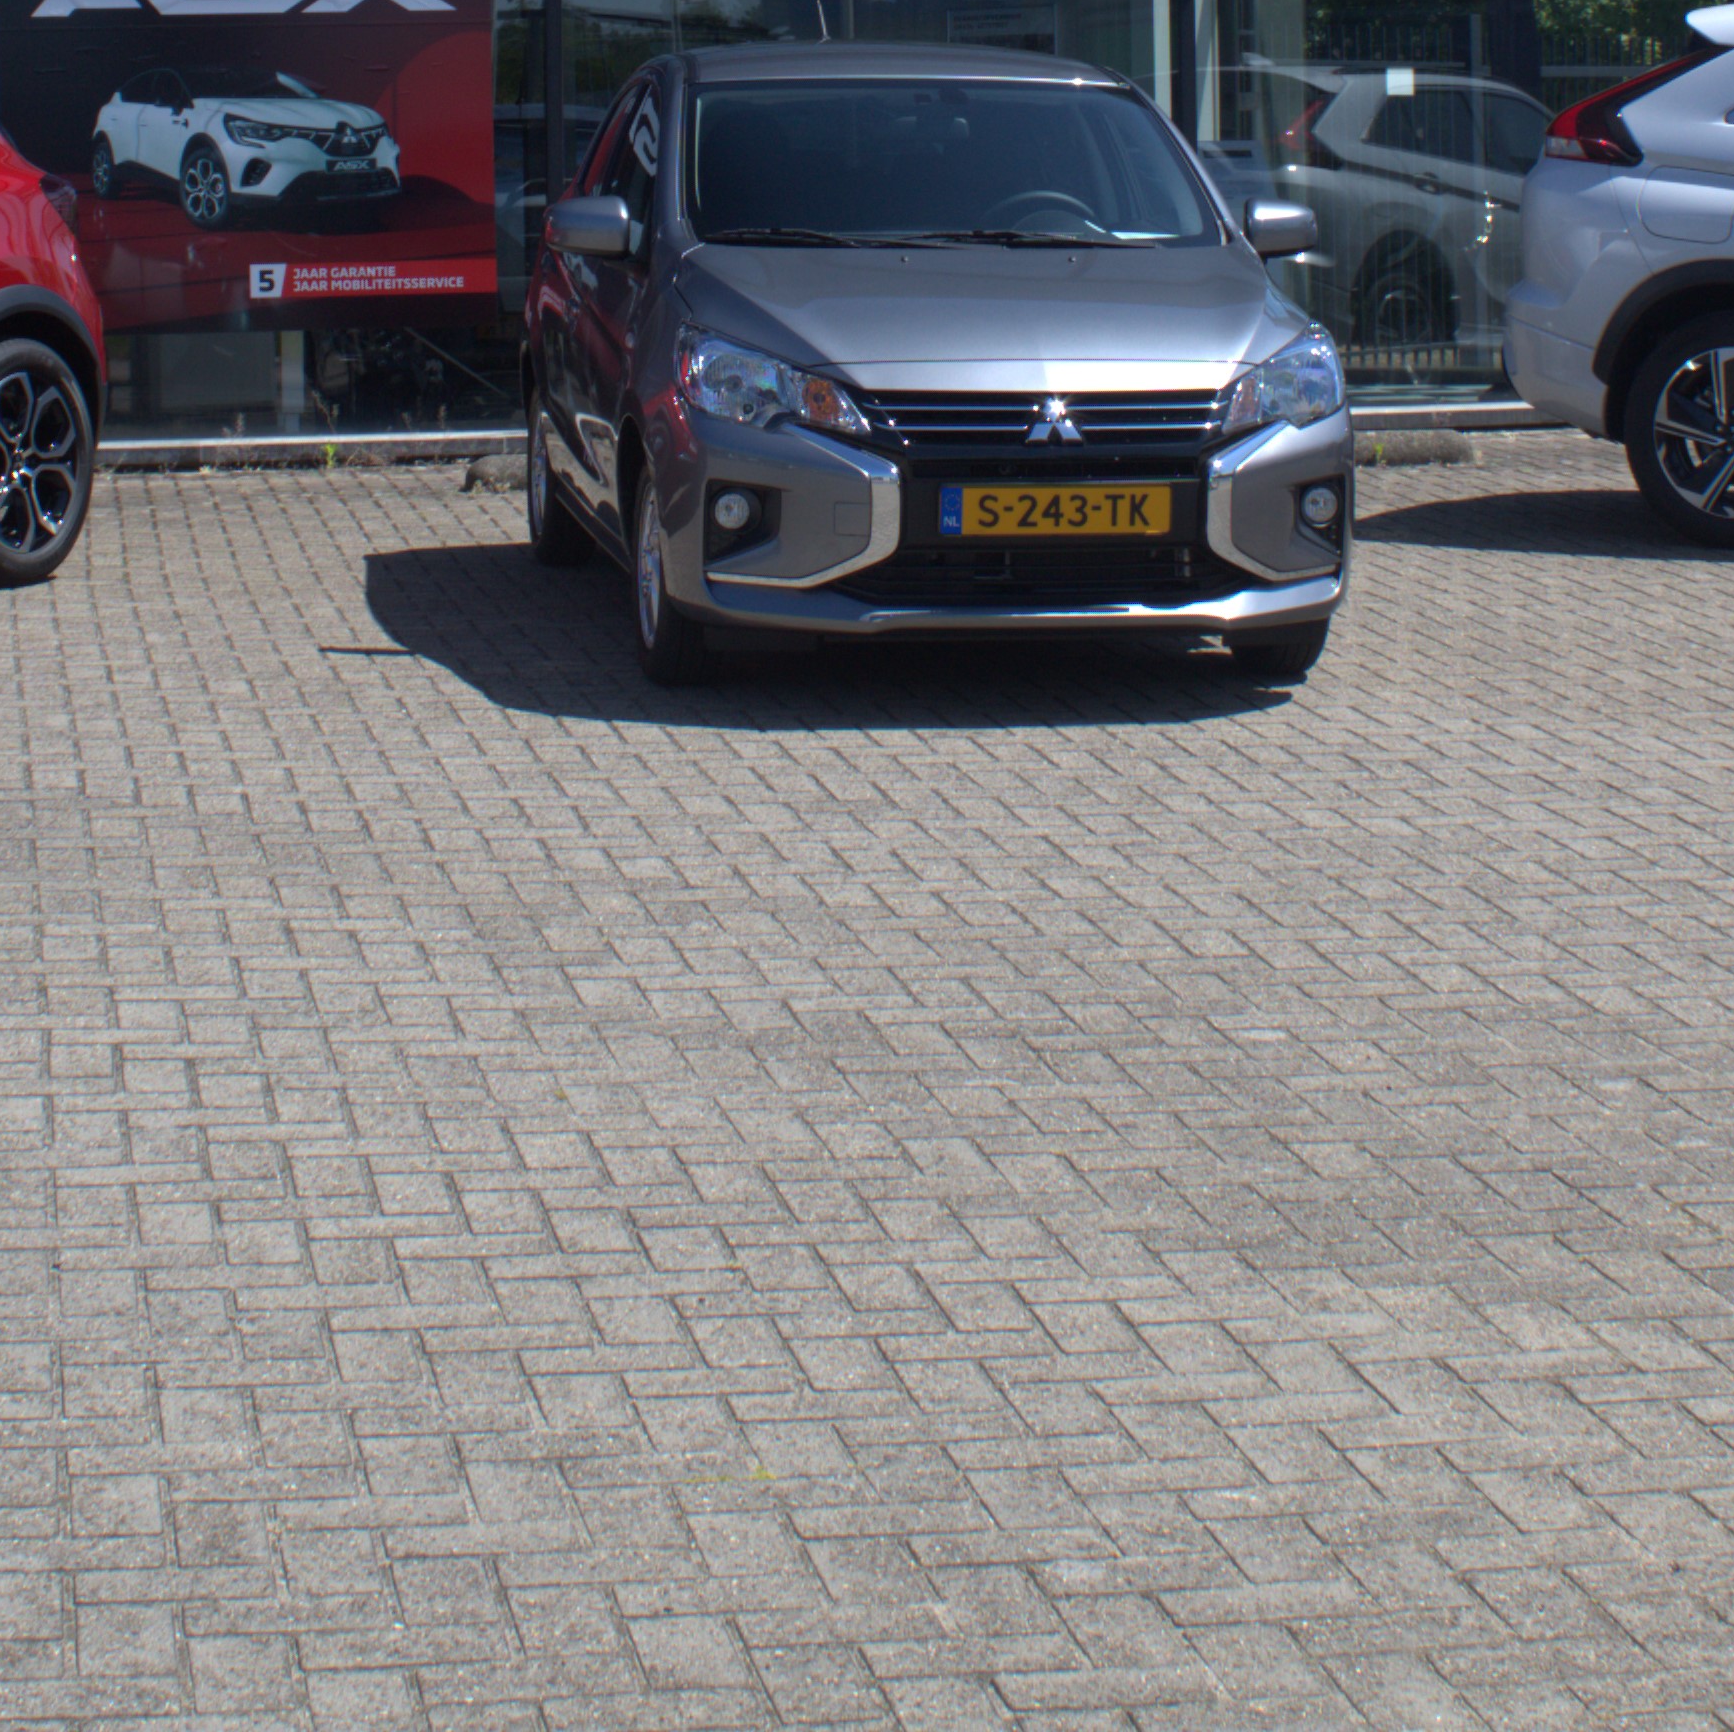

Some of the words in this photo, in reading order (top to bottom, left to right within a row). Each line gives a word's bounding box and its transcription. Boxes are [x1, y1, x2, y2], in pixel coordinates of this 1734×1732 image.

[293, 267, 328, 279] JAAR
[331, 265, 396, 278] GARANTIE
[258, 269, 275, 293] 5
[293, 279, 328, 292] JAAR
[331, 276, 464, 291] MOBILITEITSSERVICE
[977, 493, 1150, 528] S-243-TK
[943, 515, 960, 528] NL
